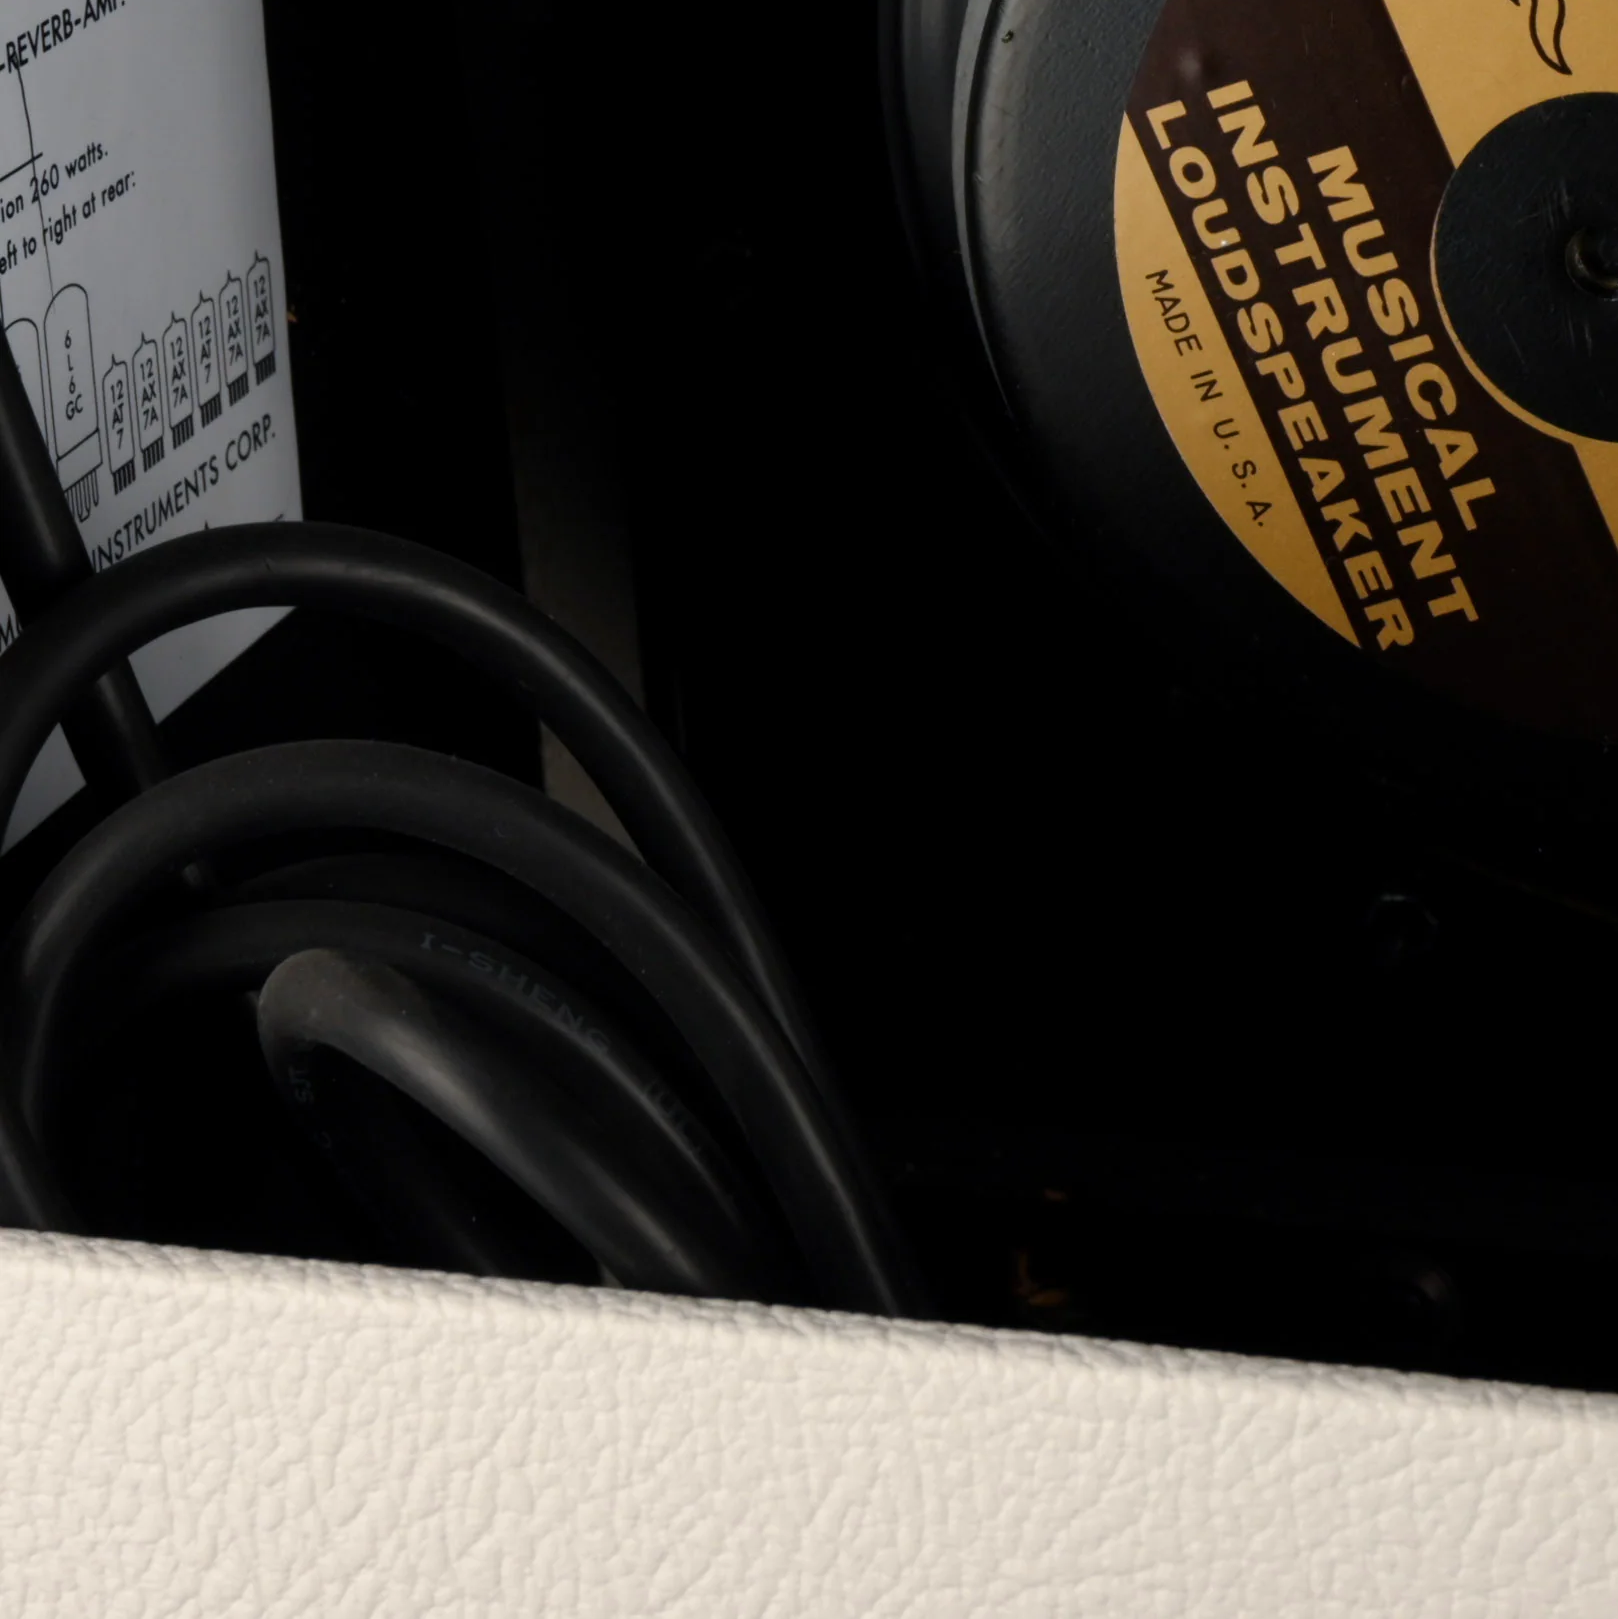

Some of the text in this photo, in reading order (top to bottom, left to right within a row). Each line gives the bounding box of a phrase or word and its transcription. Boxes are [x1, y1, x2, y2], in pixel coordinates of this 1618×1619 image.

[23, 236, 37, 259] to
[42, 203, 77, 246] right
[82, 192, 97, 219] at
[101, 171, 136, 206] rear:
[30, 163, 60, 204] 260
[65, 142, 108, 179] watts.
[1145, 269, 1204, 357] MADE
[1190, 369, 1224, 403] IN
[1145, 99, 1416, 652] LOUDSPEAKER
[1206, 79, 1480, 623] INSTRUMENT
[1306, 144, 1497, 532] MUSICAL
[91, 413, 276, 573] INSTRUMENTS CORP.
